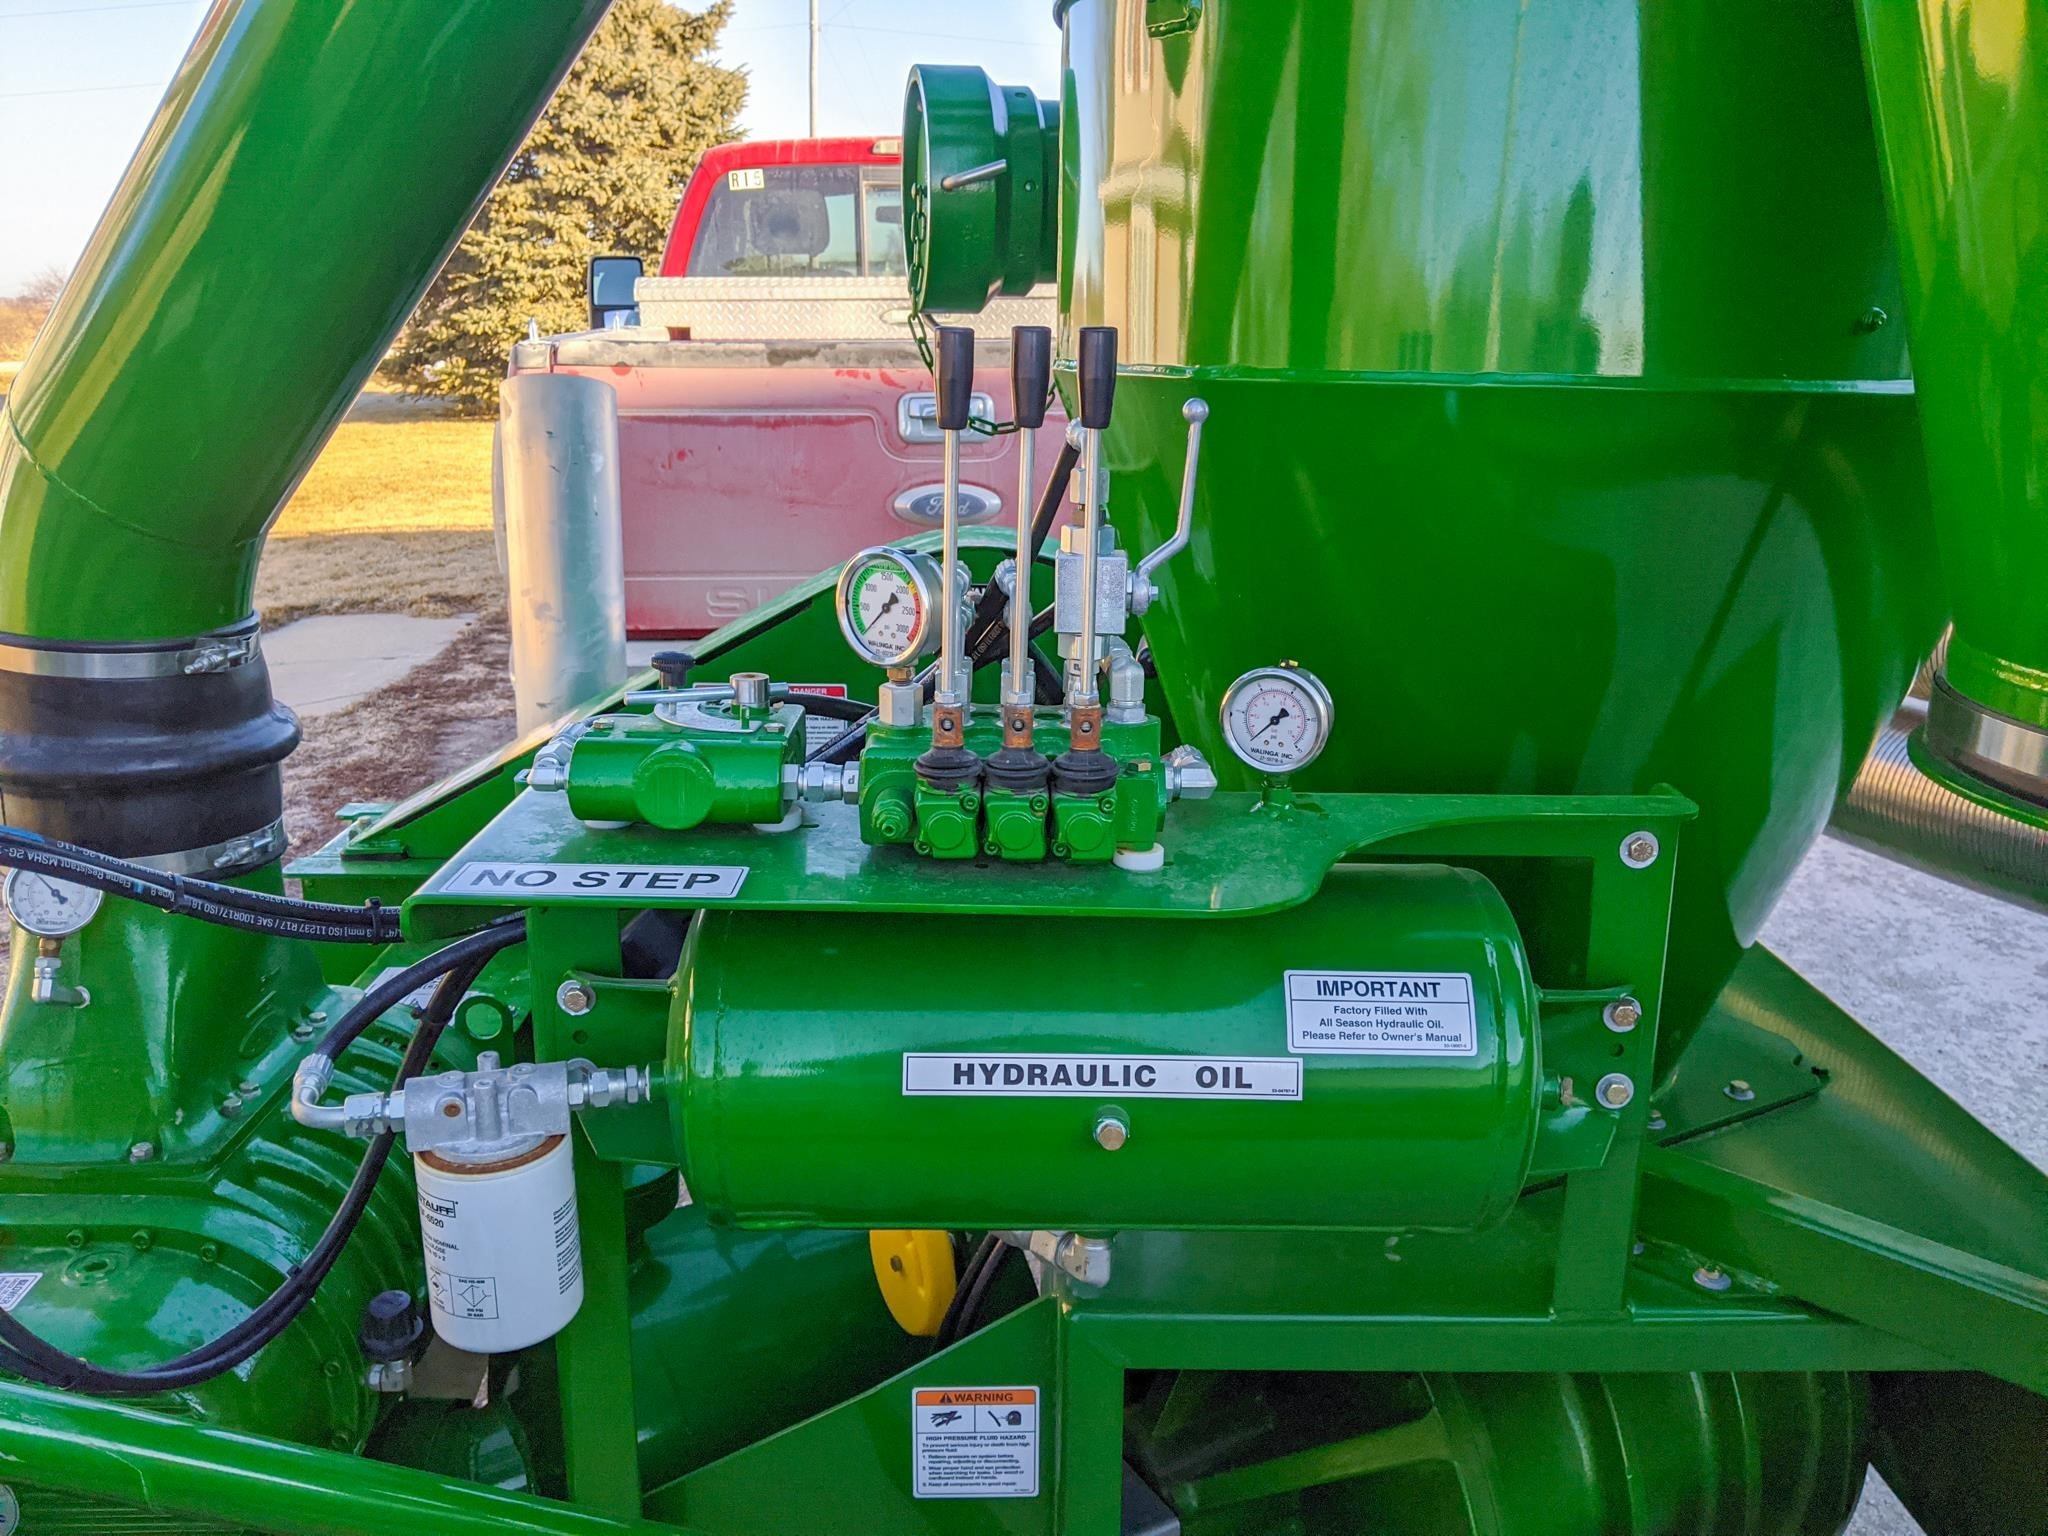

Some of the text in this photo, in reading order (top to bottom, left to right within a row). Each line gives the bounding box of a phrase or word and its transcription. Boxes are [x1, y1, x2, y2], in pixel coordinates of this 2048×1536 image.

[896, 585, 910, 596] 2000
[902, 606, 916, 616] 2500
[1250, 747, 1279, 757] WALINGA
[28, 852, 58, 867] MSHA
[61, 858, 104, 880] Resistant
[105, 872, 131, 888] Flame
[470, 869, 720, 890] NO STEP
[258, 917, 274, 928] SAE
[1316, 980, 1440, 998] IMPORTANT
[1334, 1006, 1428, 1017] Factory Filled With
[1319, 1018, 1444, 1030] All Season Hydraulic Oil.
[1302, 1030, 1462, 1042] Please Refer to Owner's Manual
[953, 1063, 1253, 1090] HYDRAULIC OIL
[954, 1393, 1013, 1402] WARNING
